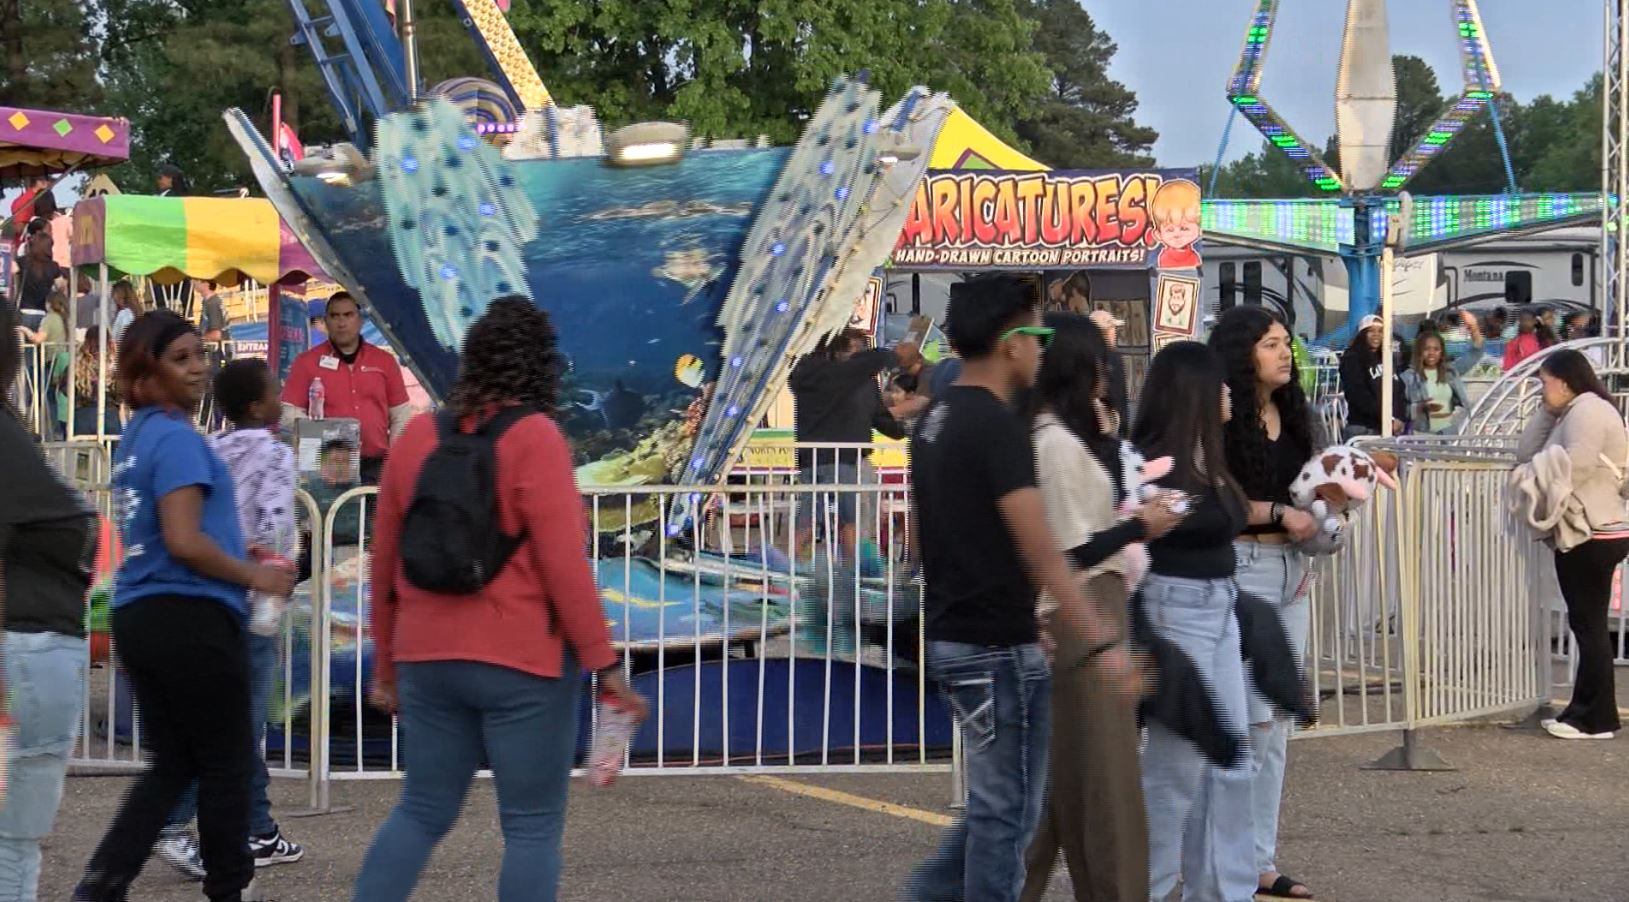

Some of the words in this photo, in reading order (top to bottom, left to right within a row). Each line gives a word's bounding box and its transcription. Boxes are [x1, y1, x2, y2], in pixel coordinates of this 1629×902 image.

[896, 174, 1159, 249] ARICATURES!
[896, 250, 991, 263] HAND-DRAWN
[994, 250, 1060, 263] CARTOON
[1062, 249, 1145, 263] PORTRAITS!
[1463, 269, 1504, 281] Montana
